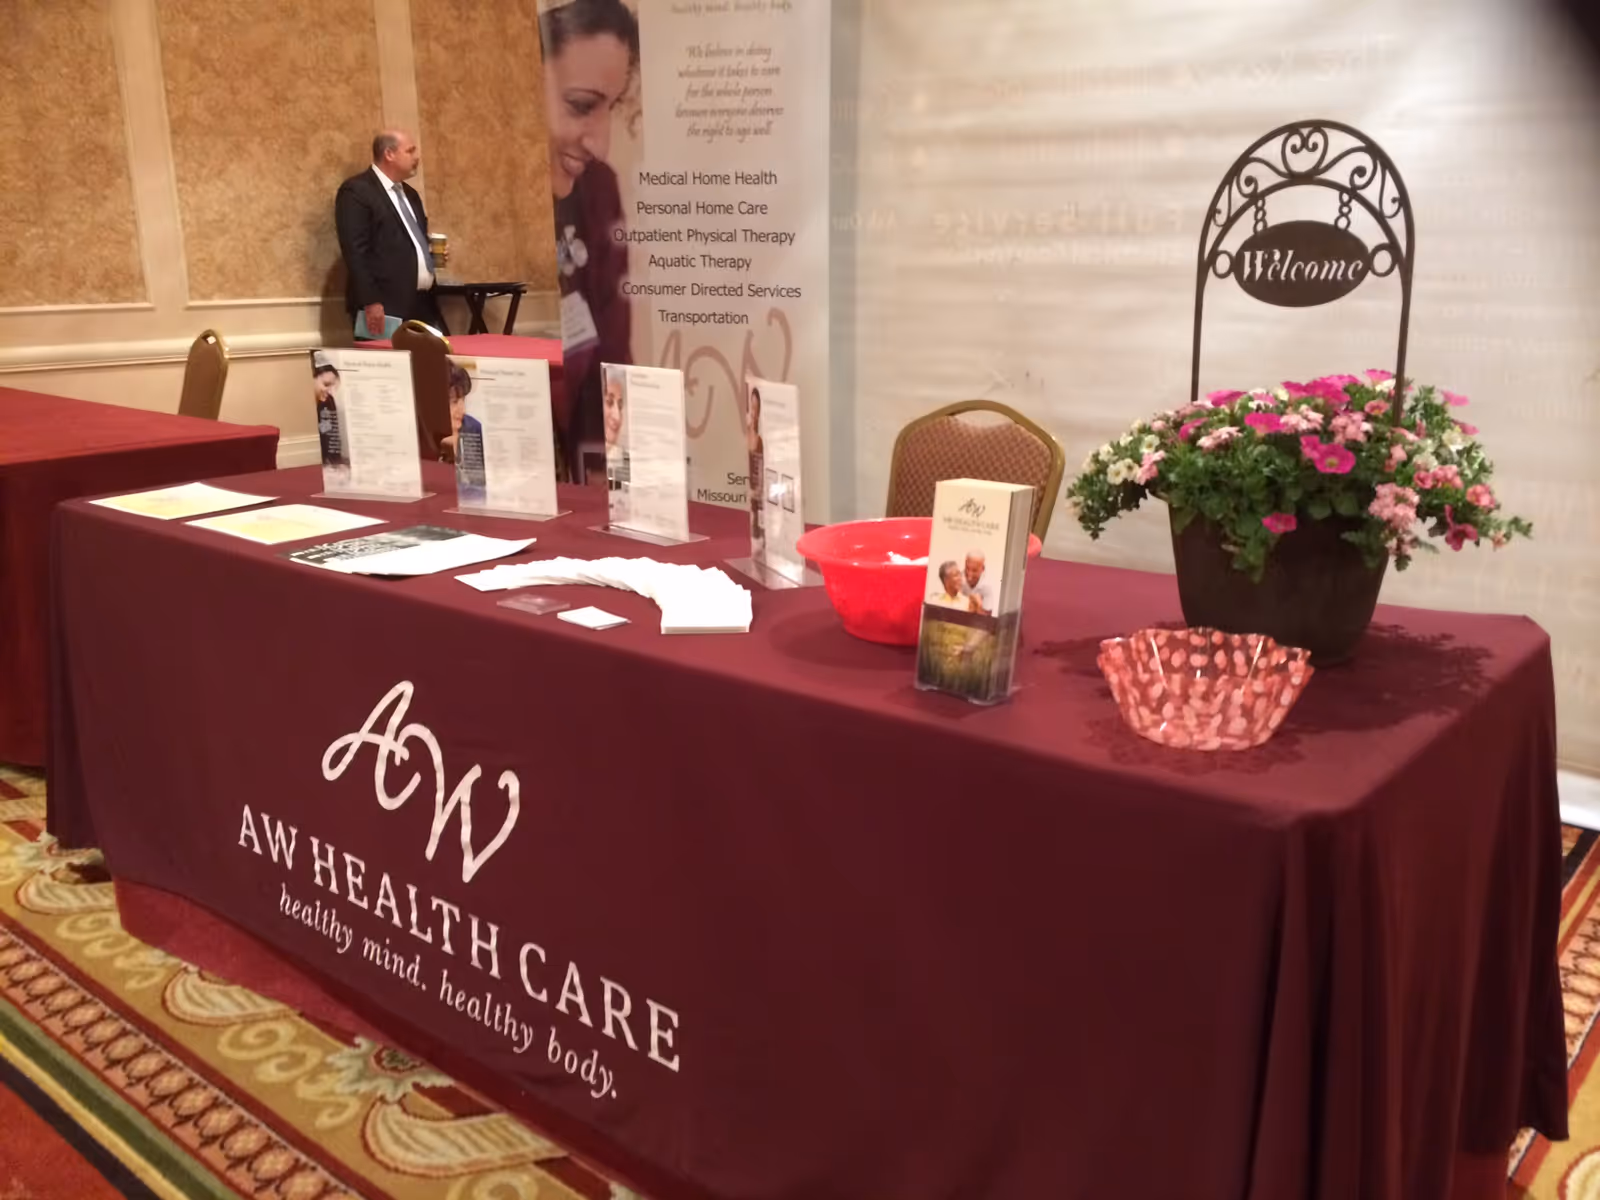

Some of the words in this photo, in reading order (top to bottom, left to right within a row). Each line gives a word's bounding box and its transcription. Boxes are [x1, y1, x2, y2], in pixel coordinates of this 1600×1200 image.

[638, 171, 688, 186] Medical
[692, 172, 730, 186] Home
[734, 170, 777, 186] Health
[636, 201, 691, 215] Personal
[695, 202, 733, 215] Home
[738, 201, 768, 215] Care
[614, 228, 682, 243] Outpatient
[687, 228, 737, 245] Physical
[741, 229, 795, 246] Therapy
[648, 254, 696, 270] Aquatic
[700, 254, 752, 272] Therapy
[1243, 249, 1363, 282] Welcome
[622, 282, 686, 296] Consumer
[691, 282, 743, 297] Directed
[747, 283, 801, 298] Services
[658, 309, 748, 325] Transportation
[697, 488, 747, 503] Missouri
[322, 680, 520, 883] AW
[237, 804, 297, 870] AW
[310, 836, 501, 979] HEALTH
[519, 943, 680, 1072] CARE
[279, 883, 353, 954] healthy
[362, 934, 427, 990] mind.
[440, 970, 533, 1053] healthy
[547, 1027, 617, 1098] body.
